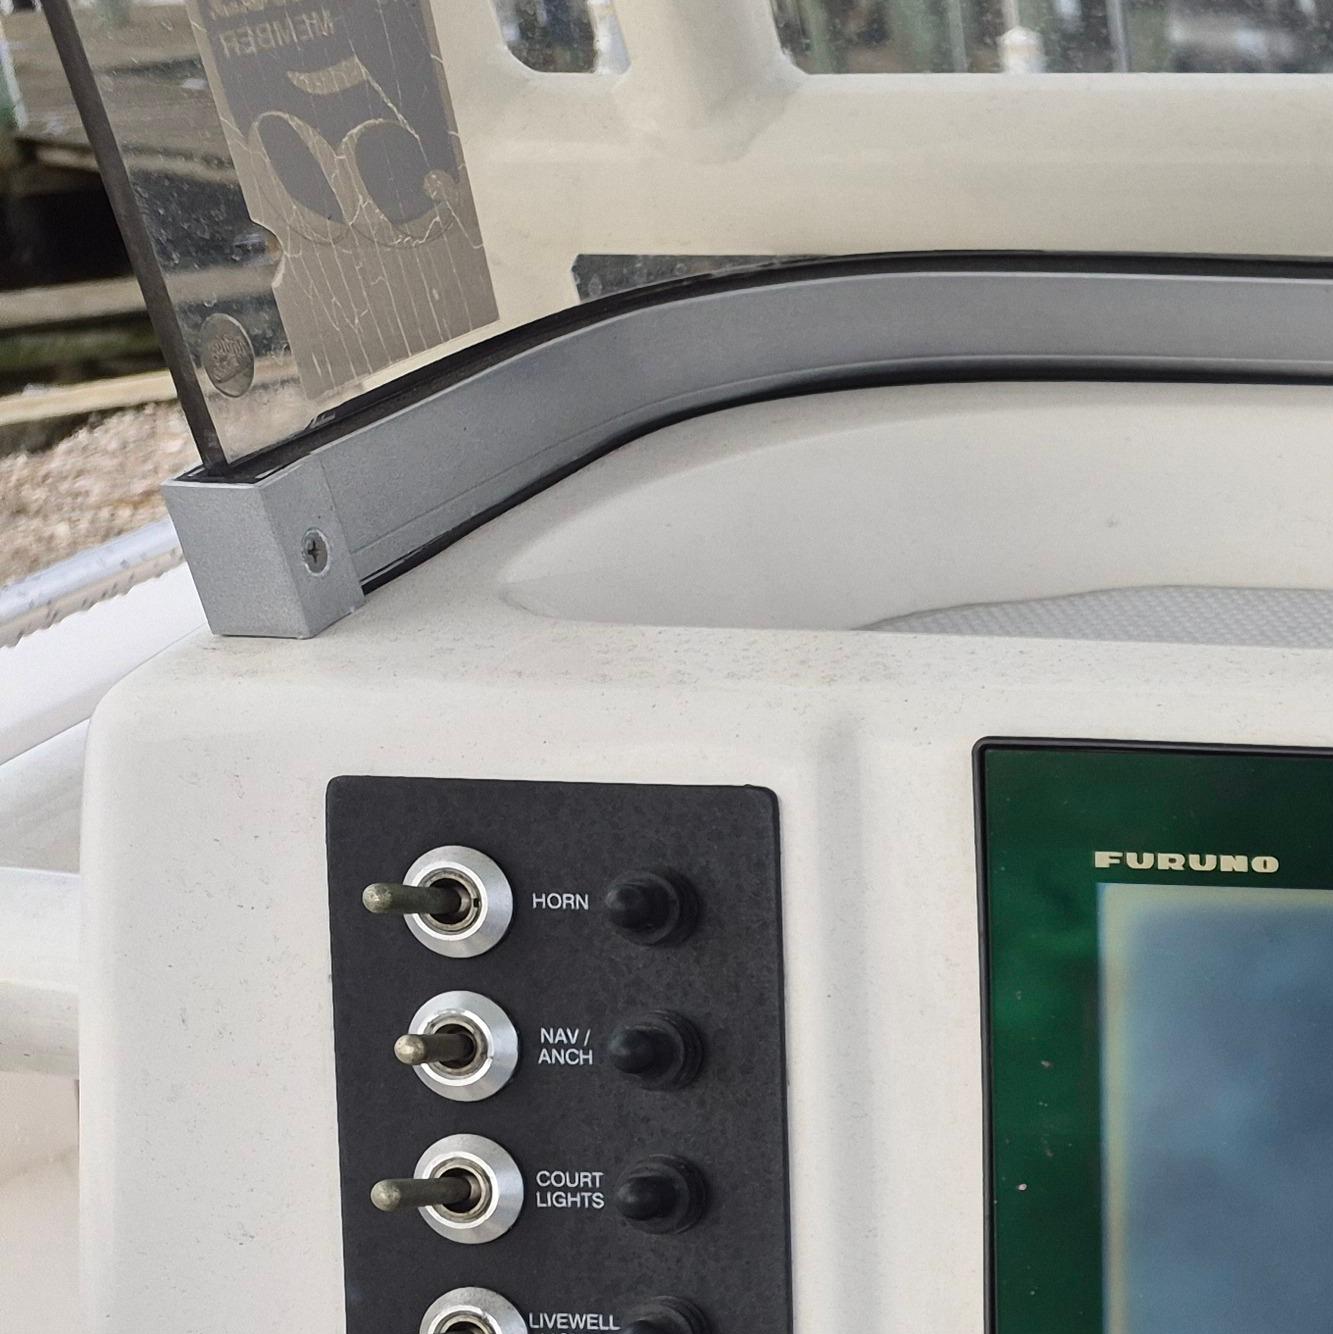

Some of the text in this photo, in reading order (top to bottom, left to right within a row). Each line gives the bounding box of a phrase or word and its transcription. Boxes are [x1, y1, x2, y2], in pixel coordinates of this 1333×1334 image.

[1094, 850, 1280, 873] FURUNO
[532, 892, 589, 910] HORN
[540, 1027, 579, 1045] NAV
[538, 1048, 593, 1065] ANCH
[536, 1171, 604, 1188] COURT
[536, 1191, 605, 1209] LIGHTS
[529, 1313, 620, 1331] LIVEWELL
